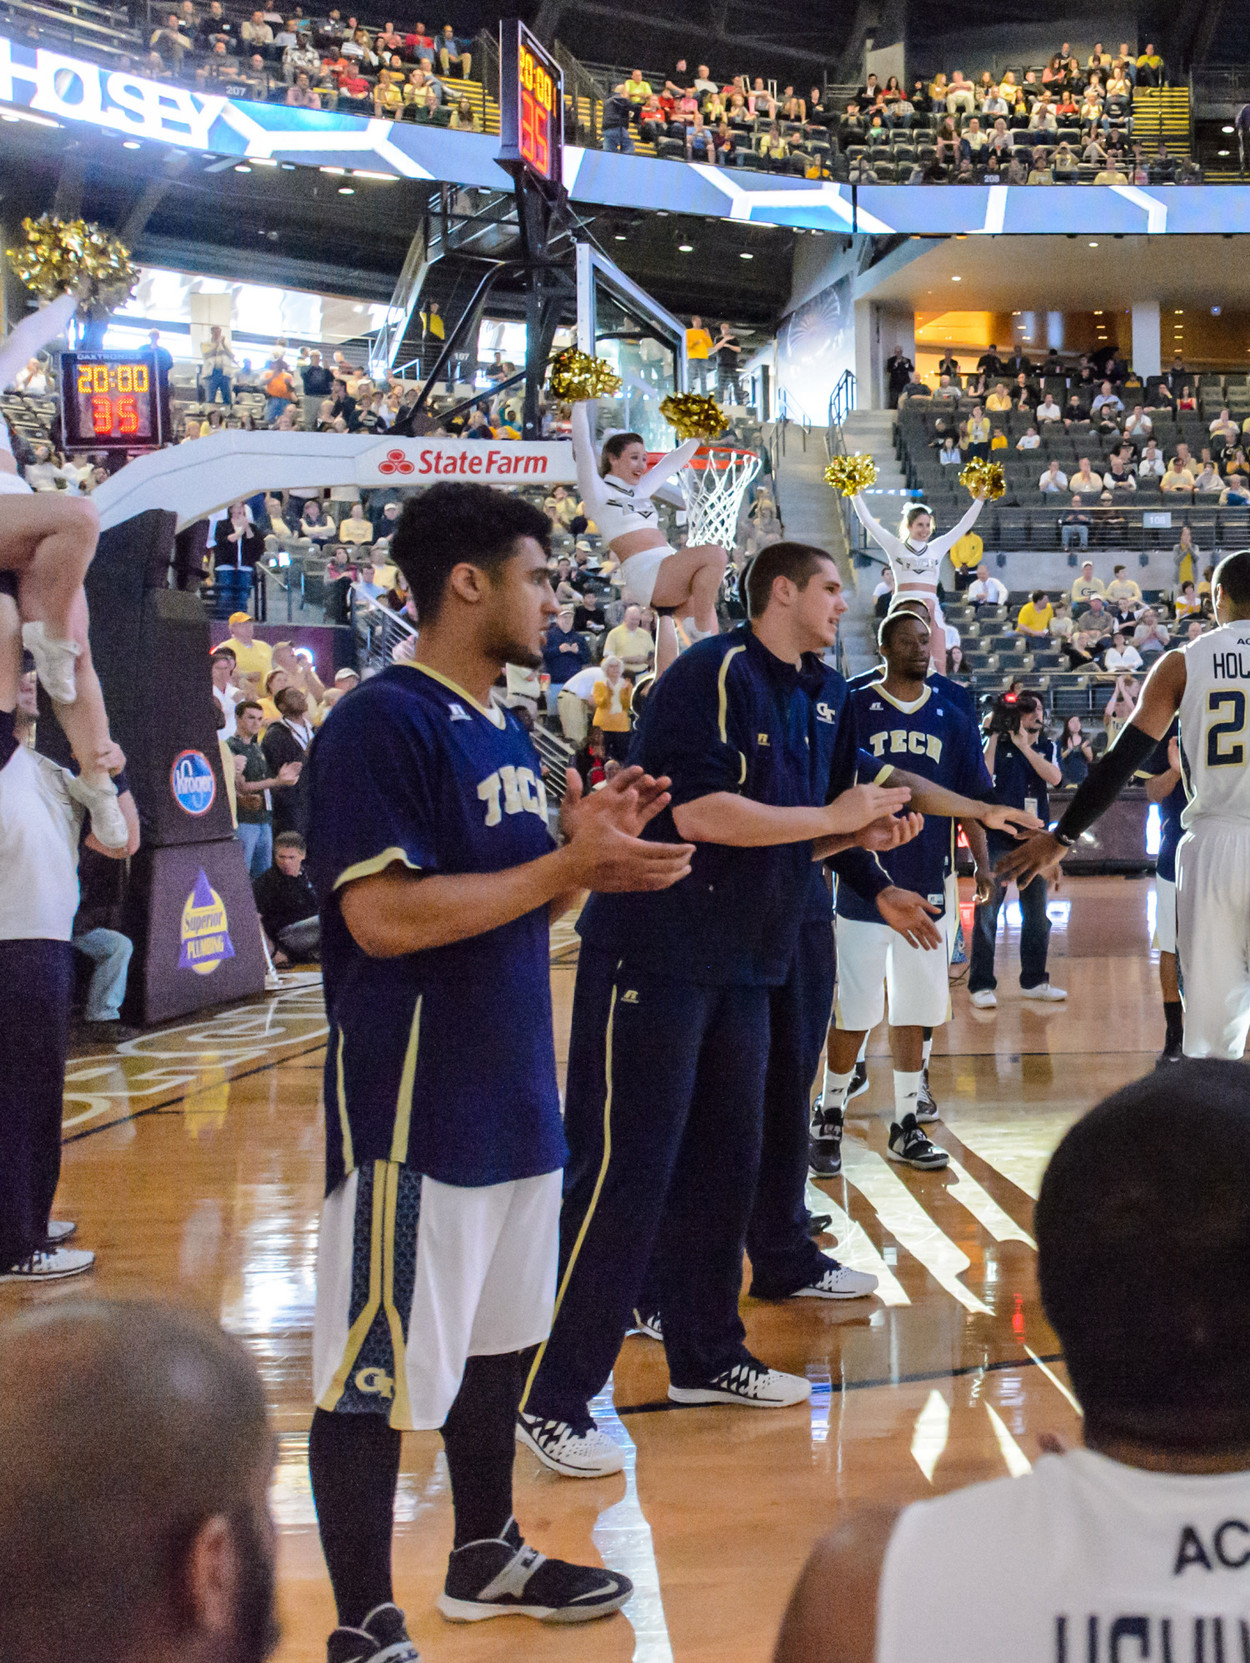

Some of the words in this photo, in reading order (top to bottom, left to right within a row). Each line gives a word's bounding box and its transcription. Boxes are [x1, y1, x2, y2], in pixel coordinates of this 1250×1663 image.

[0, 37, 228, 150] HOLSEY
[226, 85, 247, 97] 207
[521, 88, 549, 176] 35
[78, 365, 149, 393] 20:00
[92, 396, 139, 434] 35
[869, 729, 943, 765] TECH
[176, 759, 214, 808] Kroger
[185, 911, 223, 936] Superior
